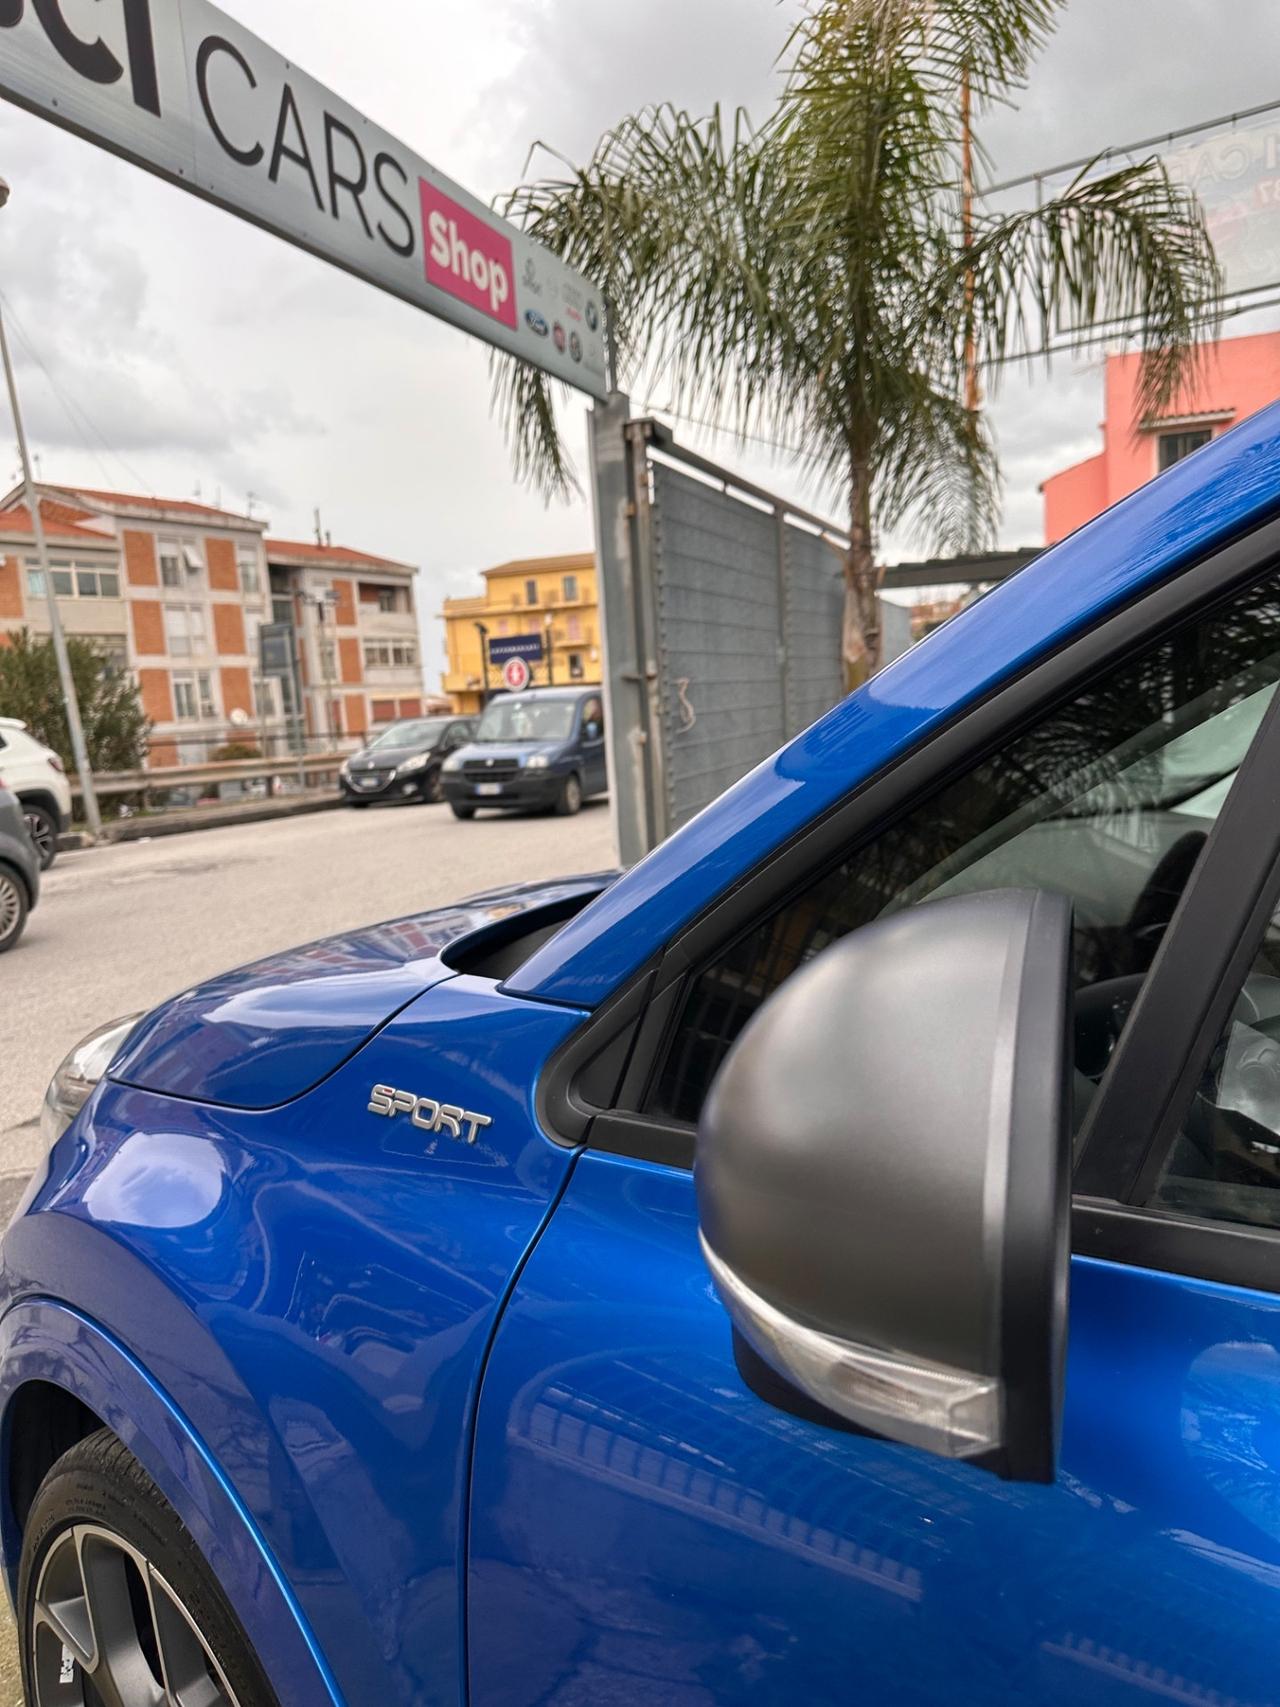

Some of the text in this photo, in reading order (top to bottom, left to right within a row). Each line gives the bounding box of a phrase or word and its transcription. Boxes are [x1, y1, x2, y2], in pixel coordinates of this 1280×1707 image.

[0, 0, 415, 258] CI CARS
[428, 210, 509, 312] Shop
[367, 1083, 493, 1144] SPORT
